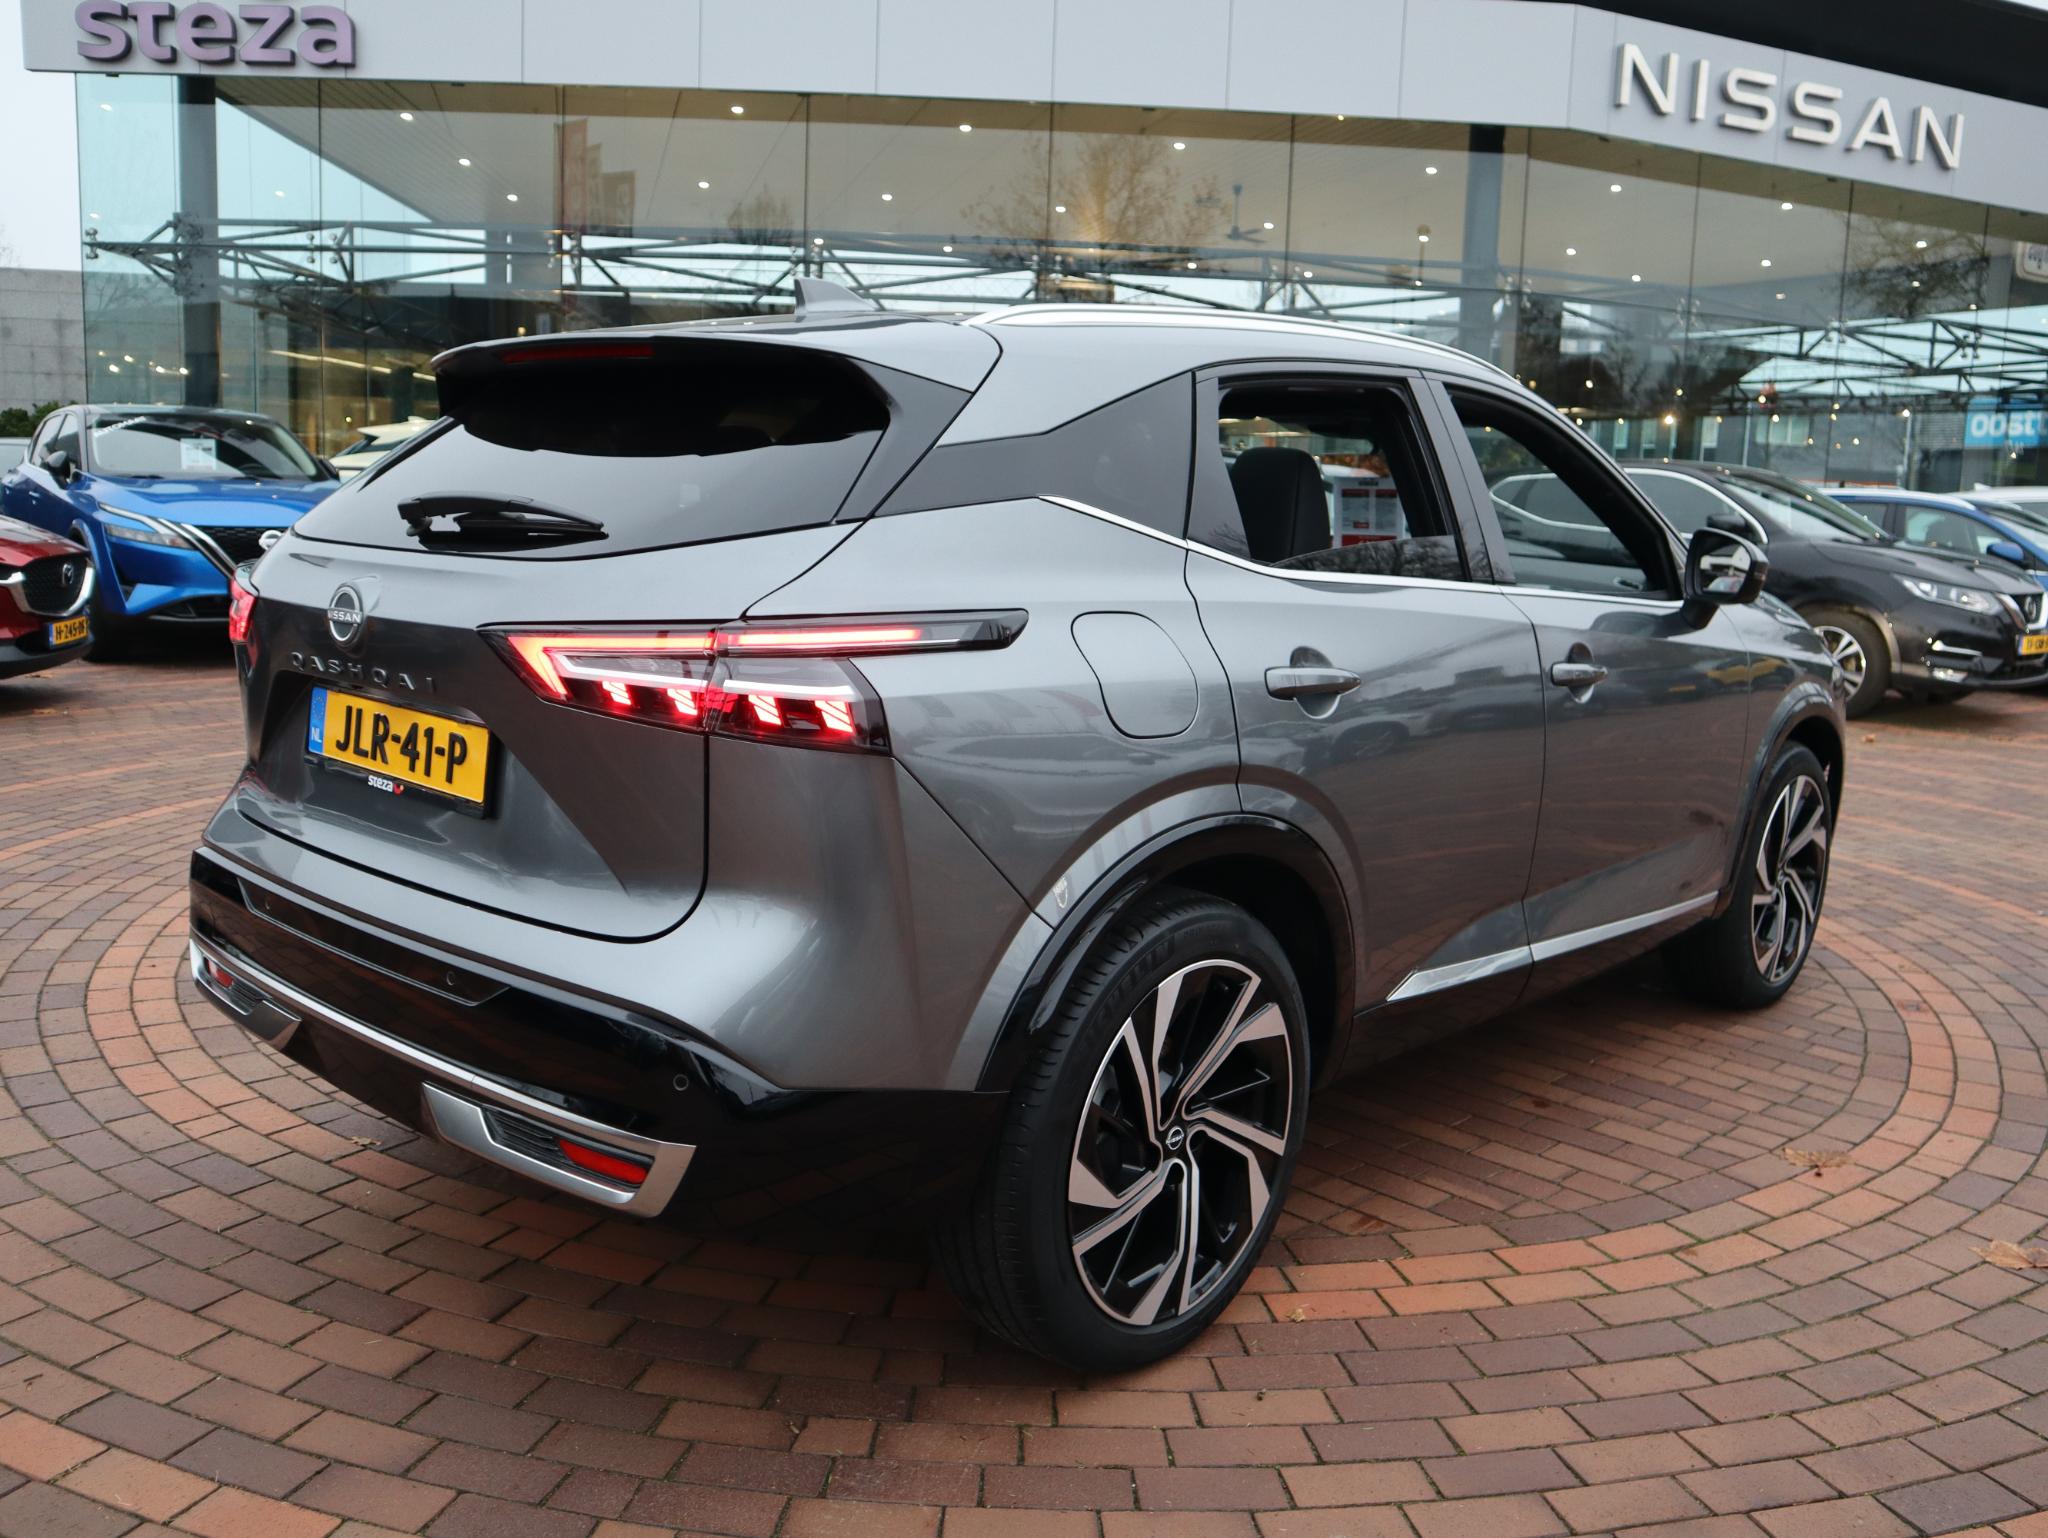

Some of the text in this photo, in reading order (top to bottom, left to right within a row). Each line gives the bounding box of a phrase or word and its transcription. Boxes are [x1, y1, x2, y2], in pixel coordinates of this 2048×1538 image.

[75, 0, 356, 67] steza
[1615, 43, 1965, 170] NISSAN
[290, 651, 435, 692] QASHQAI
[335, 705, 468, 784] JLR-41-P
[367, 774, 394, 793] steza
